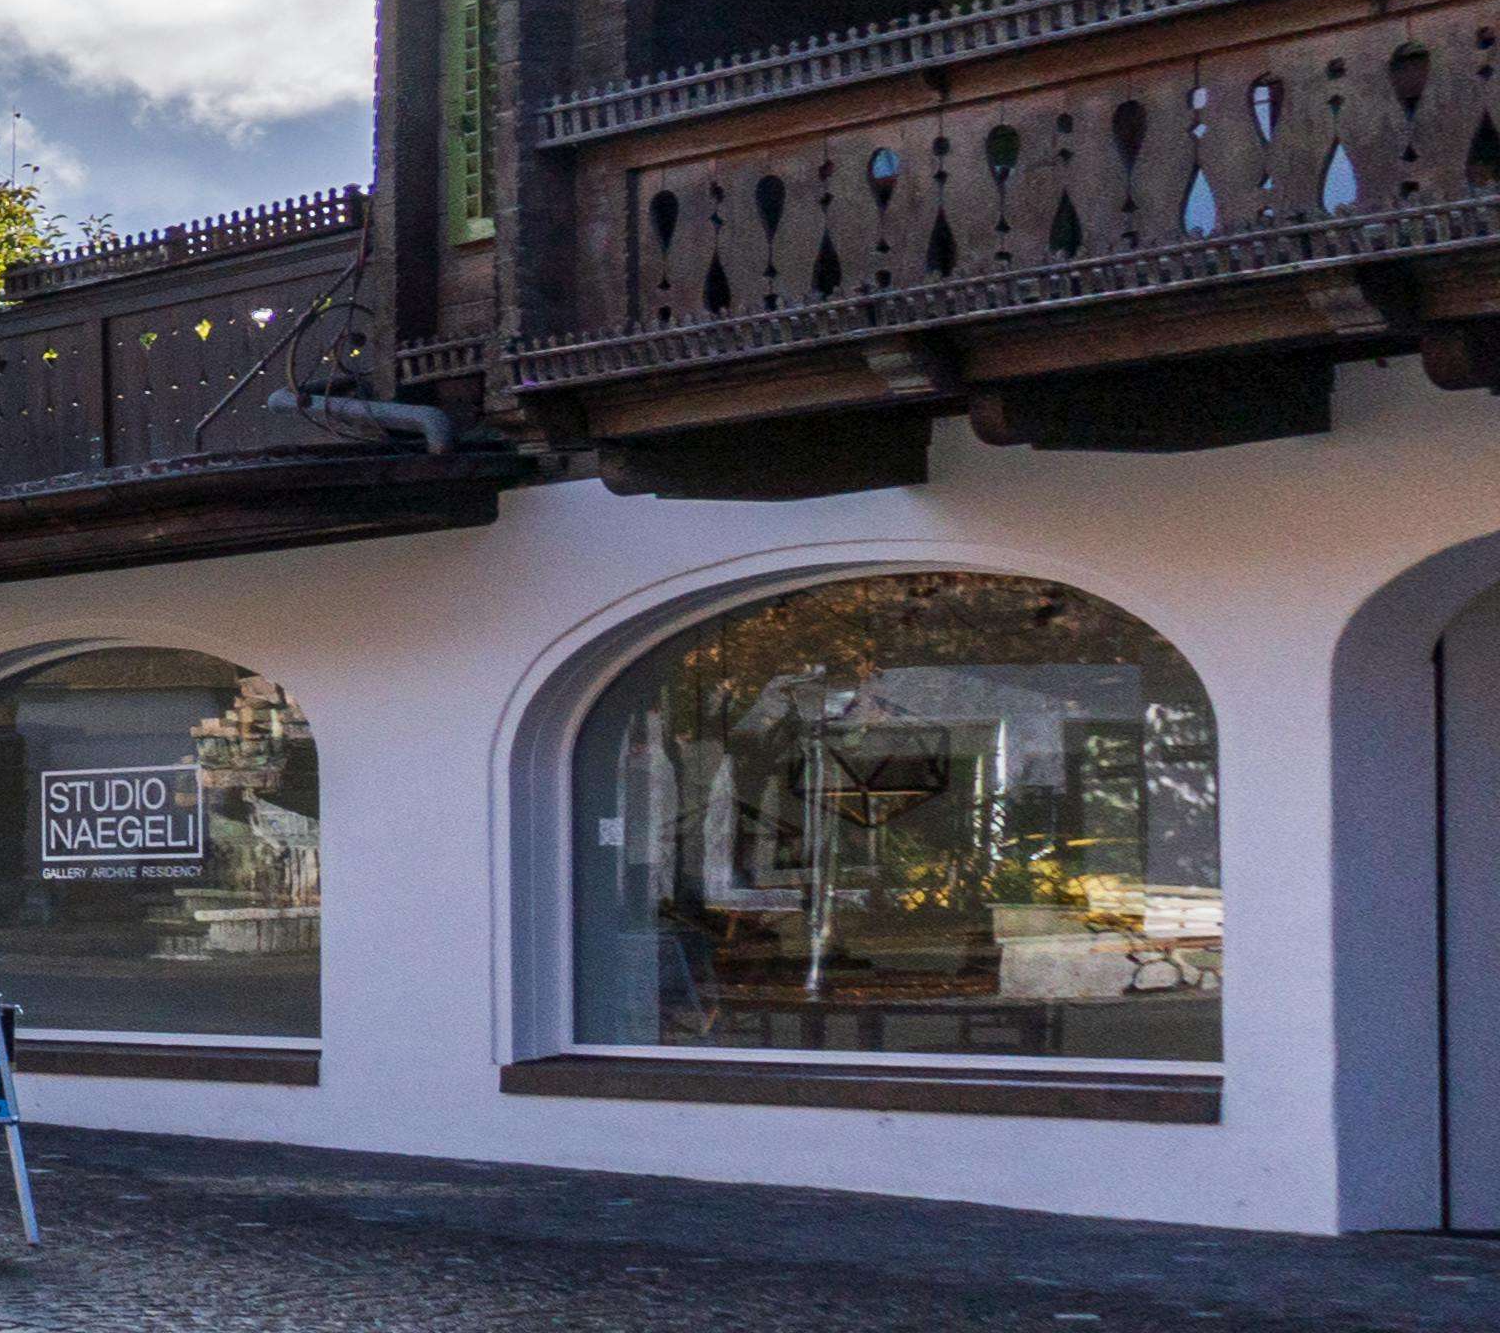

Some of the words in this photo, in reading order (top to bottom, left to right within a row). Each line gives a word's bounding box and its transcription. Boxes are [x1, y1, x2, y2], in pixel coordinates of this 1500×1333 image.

[49, 777, 166, 813] STUDIO
[50, 814, 194, 850] NAEGELI
[43, 868, 88, 879] GALLERY
[91, 866, 137, 878] ARCHIVE
[141, 865, 203, 878] RESIDENCY
